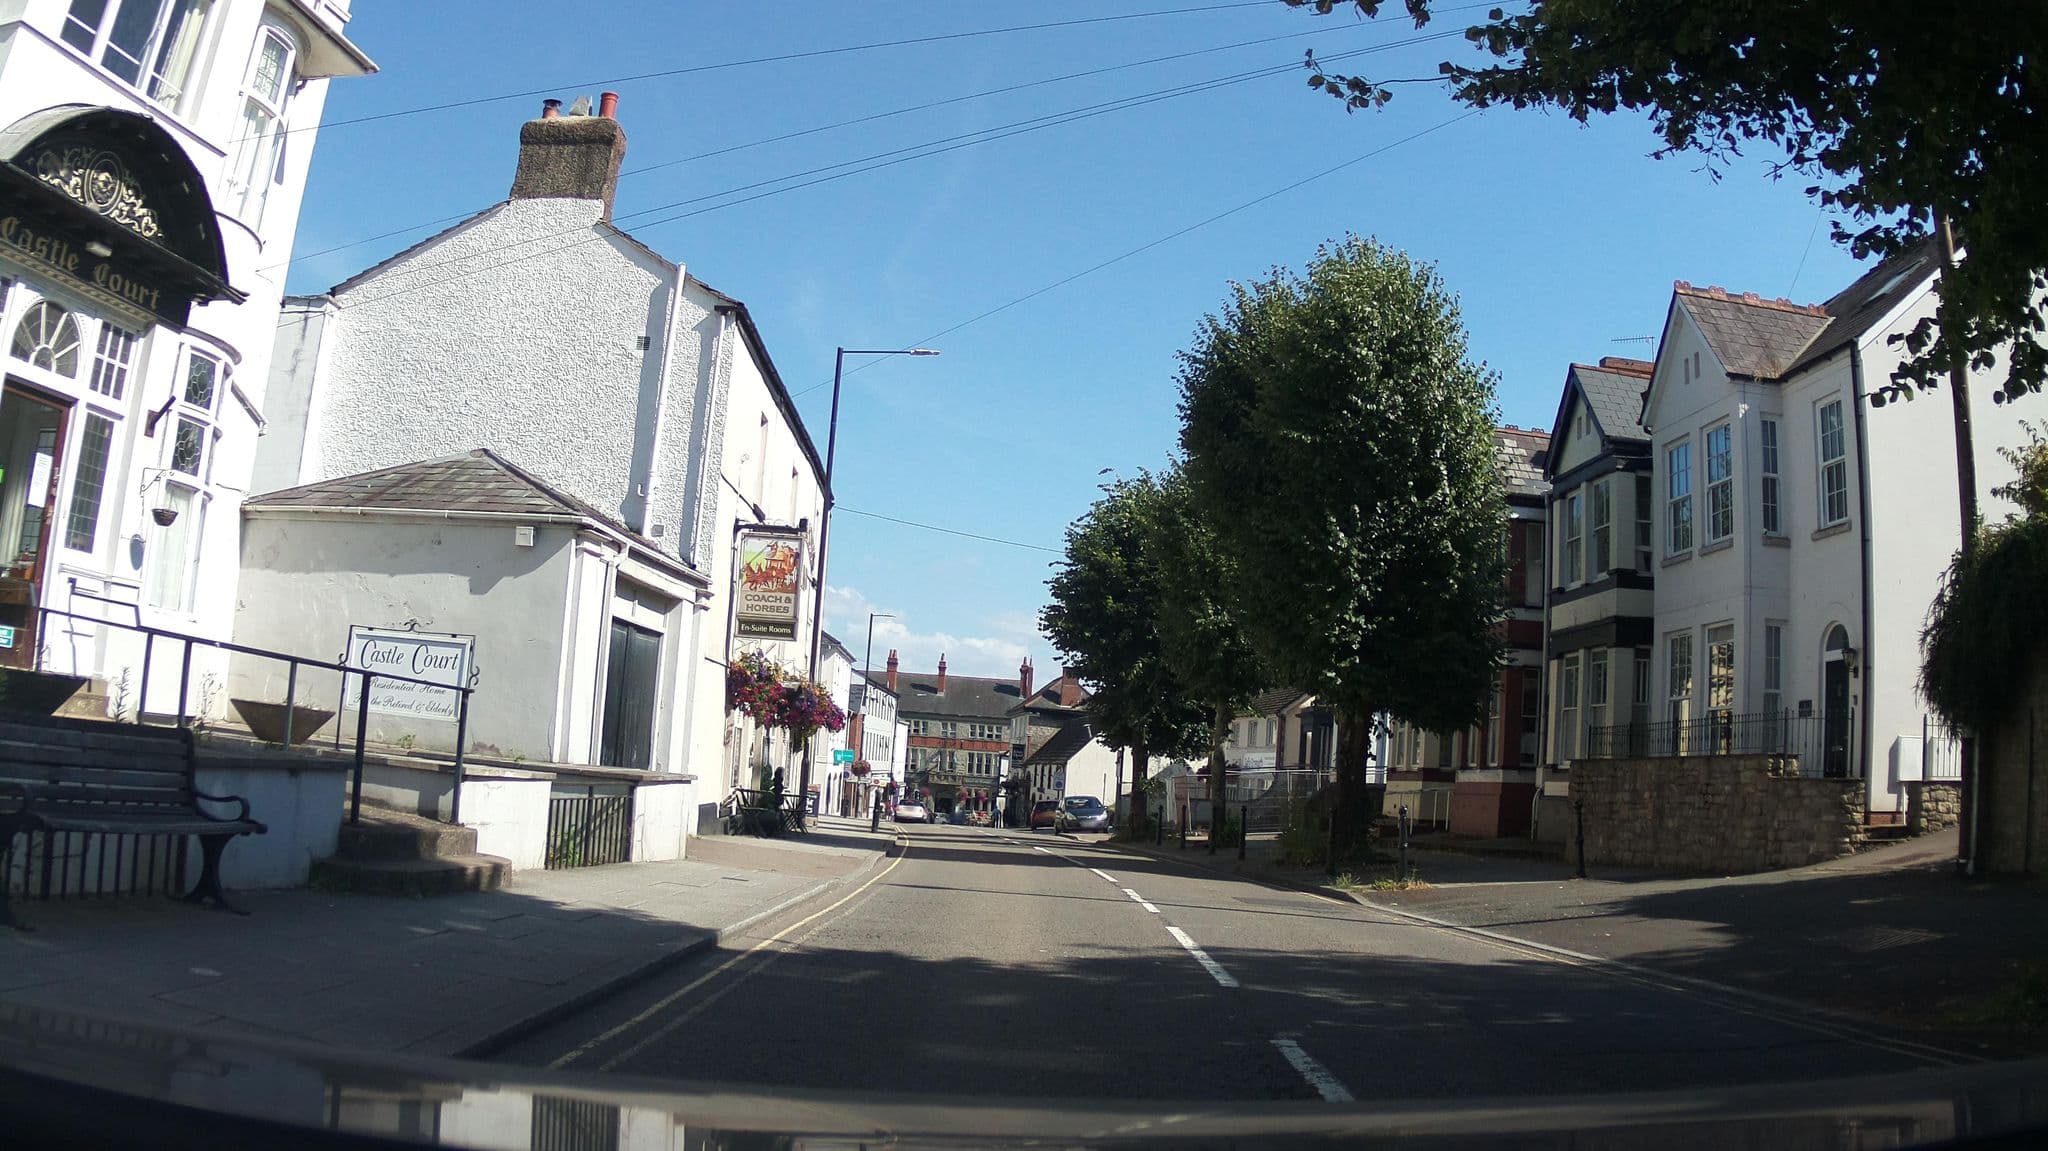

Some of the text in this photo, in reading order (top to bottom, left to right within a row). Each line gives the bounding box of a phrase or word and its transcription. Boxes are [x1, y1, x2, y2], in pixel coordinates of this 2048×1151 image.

[0, 216, 160, 310] Castle Court
[745, 594, 792, 604] COACH &
[746, 604, 789, 613] HORSES
[741, 623, 791, 633] En-Suite Rooms
[360, 639, 459, 674] Castle Court
[370, 677, 446, 695] Residential Home
[382, 695, 415, 711] Retired
[425, 700, 454, 716] Elderly
